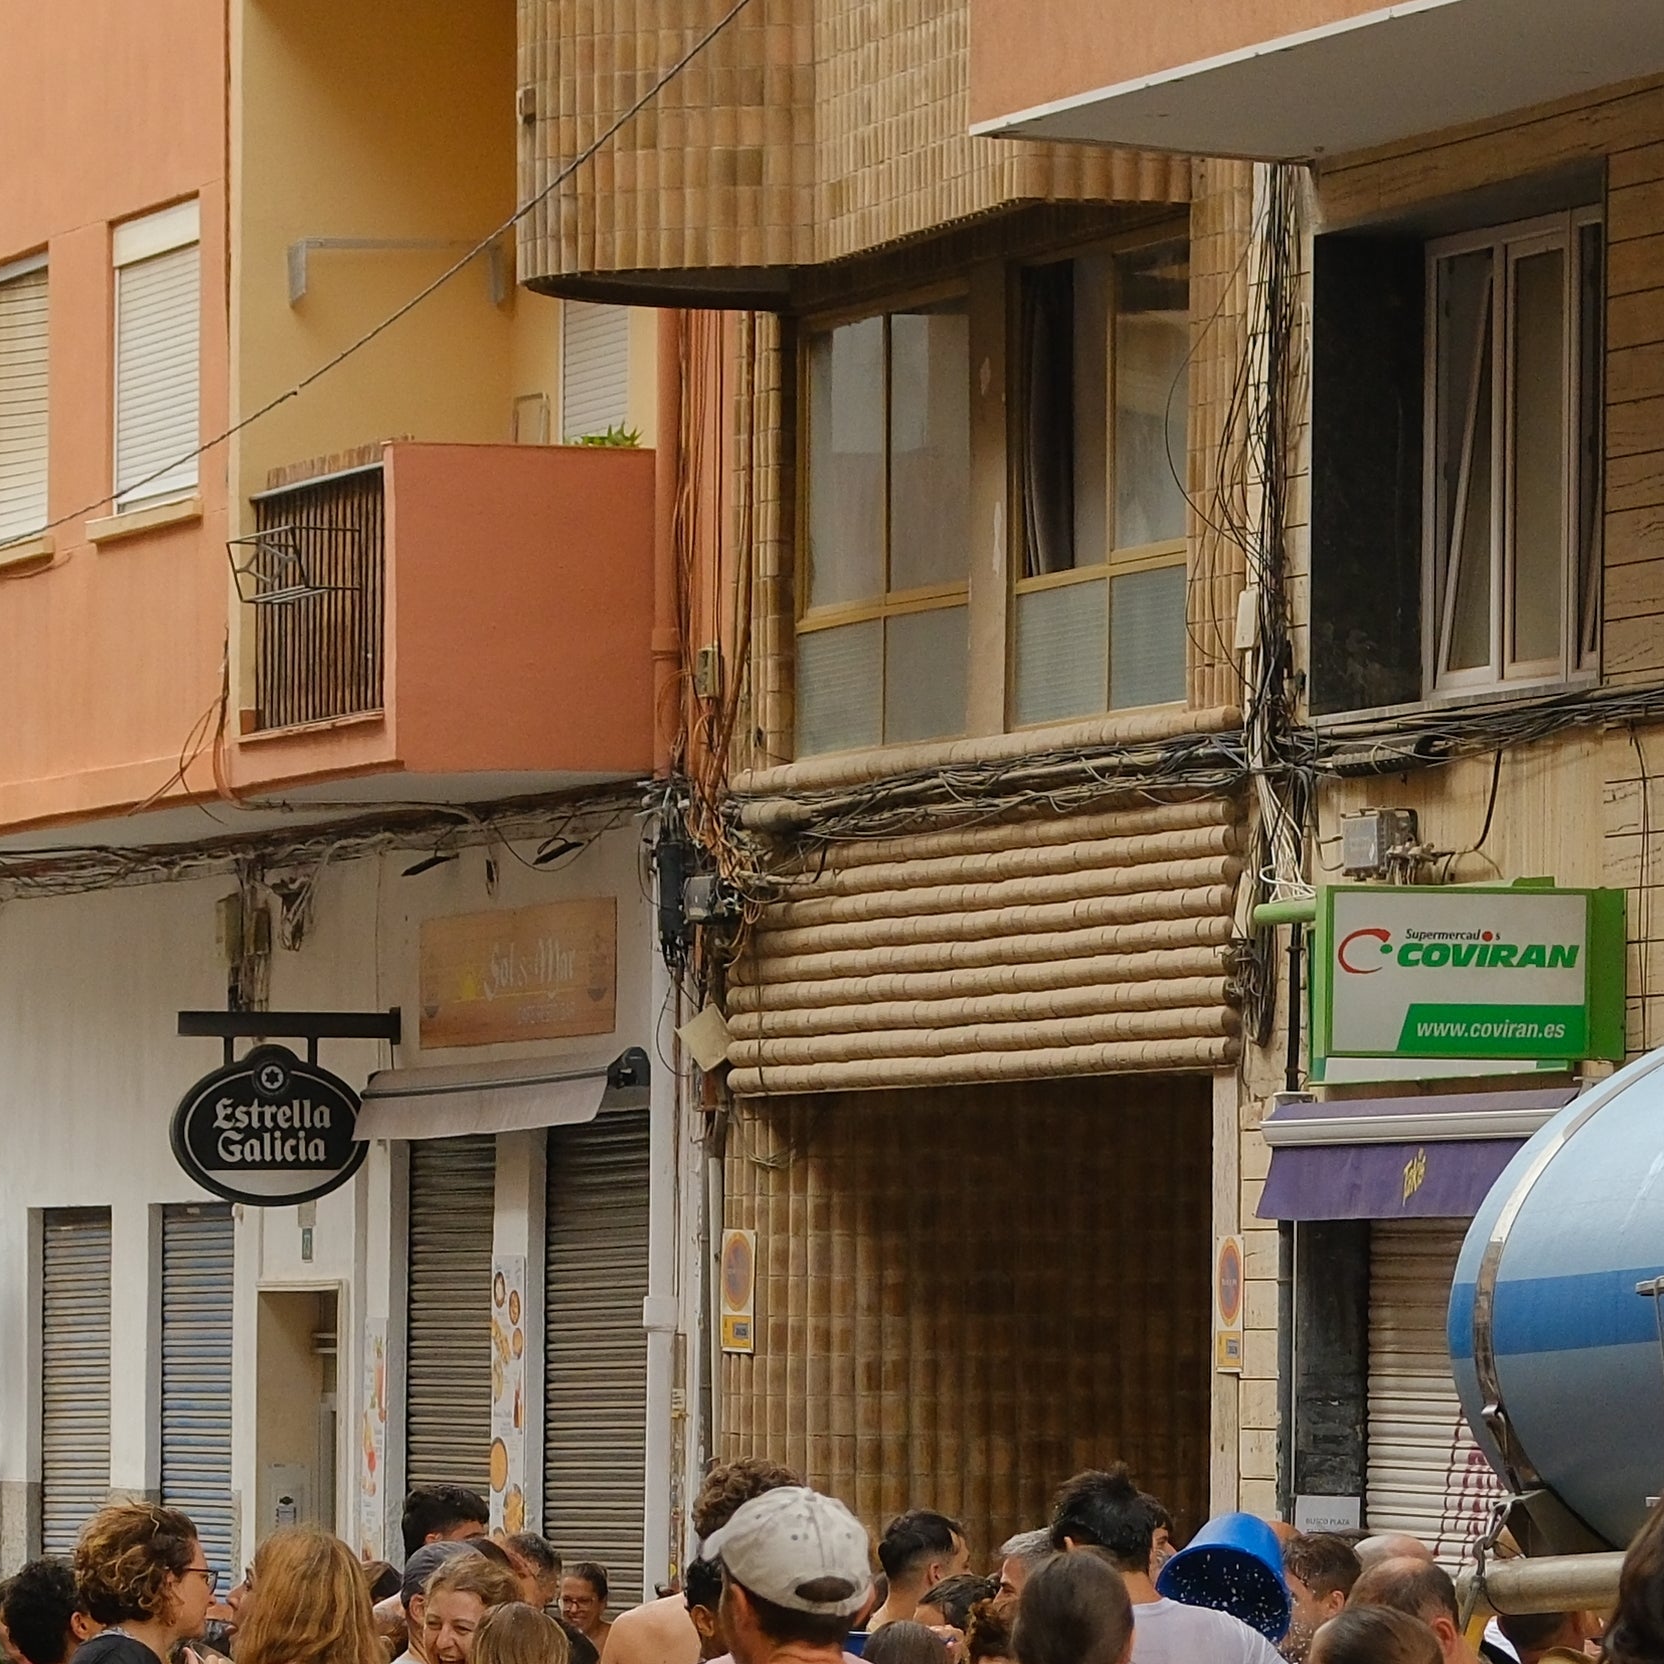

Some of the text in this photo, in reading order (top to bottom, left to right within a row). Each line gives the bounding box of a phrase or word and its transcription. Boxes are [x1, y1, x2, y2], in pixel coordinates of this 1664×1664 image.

[1397, 942, 1579, 969] COVIRAN
[1416, 1019, 1566, 1040] www.coviran.es
[212, 1098, 332, 1129] Estrella
[217, 1130, 328, 1163] Galicia
